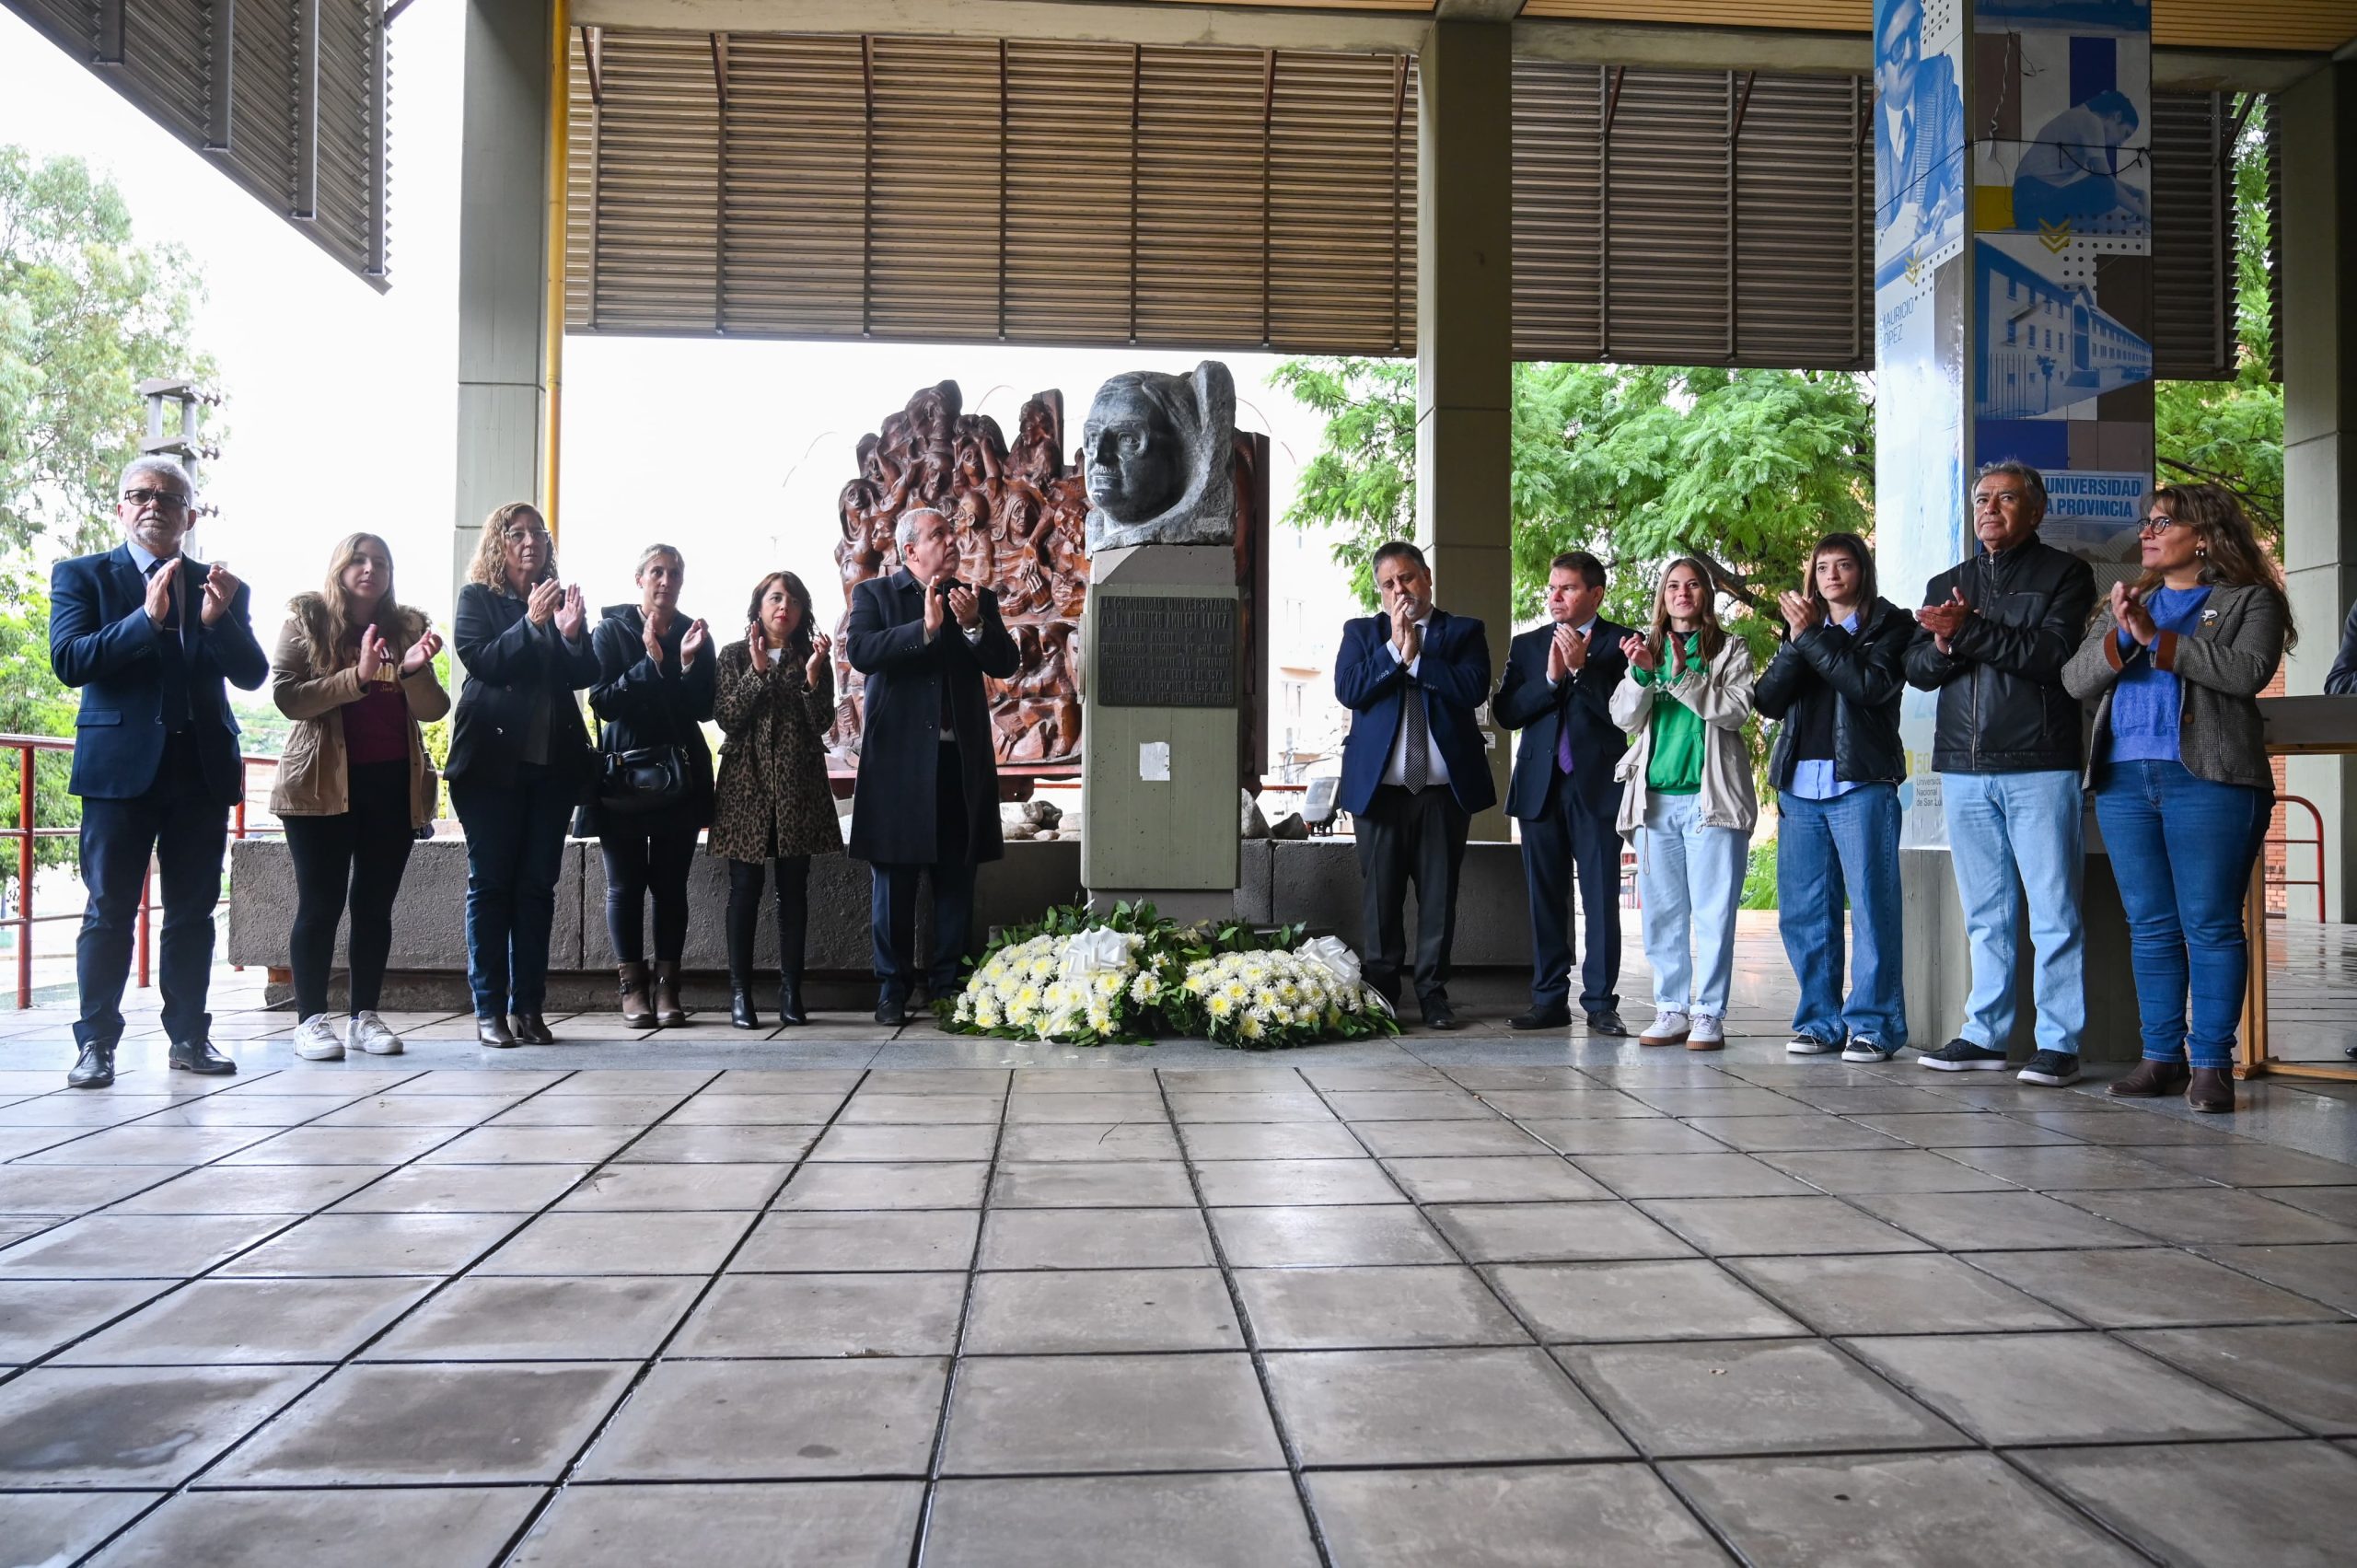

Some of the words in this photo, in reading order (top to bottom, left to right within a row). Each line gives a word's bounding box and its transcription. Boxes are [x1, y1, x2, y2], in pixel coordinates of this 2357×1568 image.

[2046, 477, 2141, 497] UNIVERSIDAD
[2057, 498, 2133, 517] PROVINCIA
[1917, 752, 1931, 773] 50
[1917, 787, 1938, 796] Nacional
